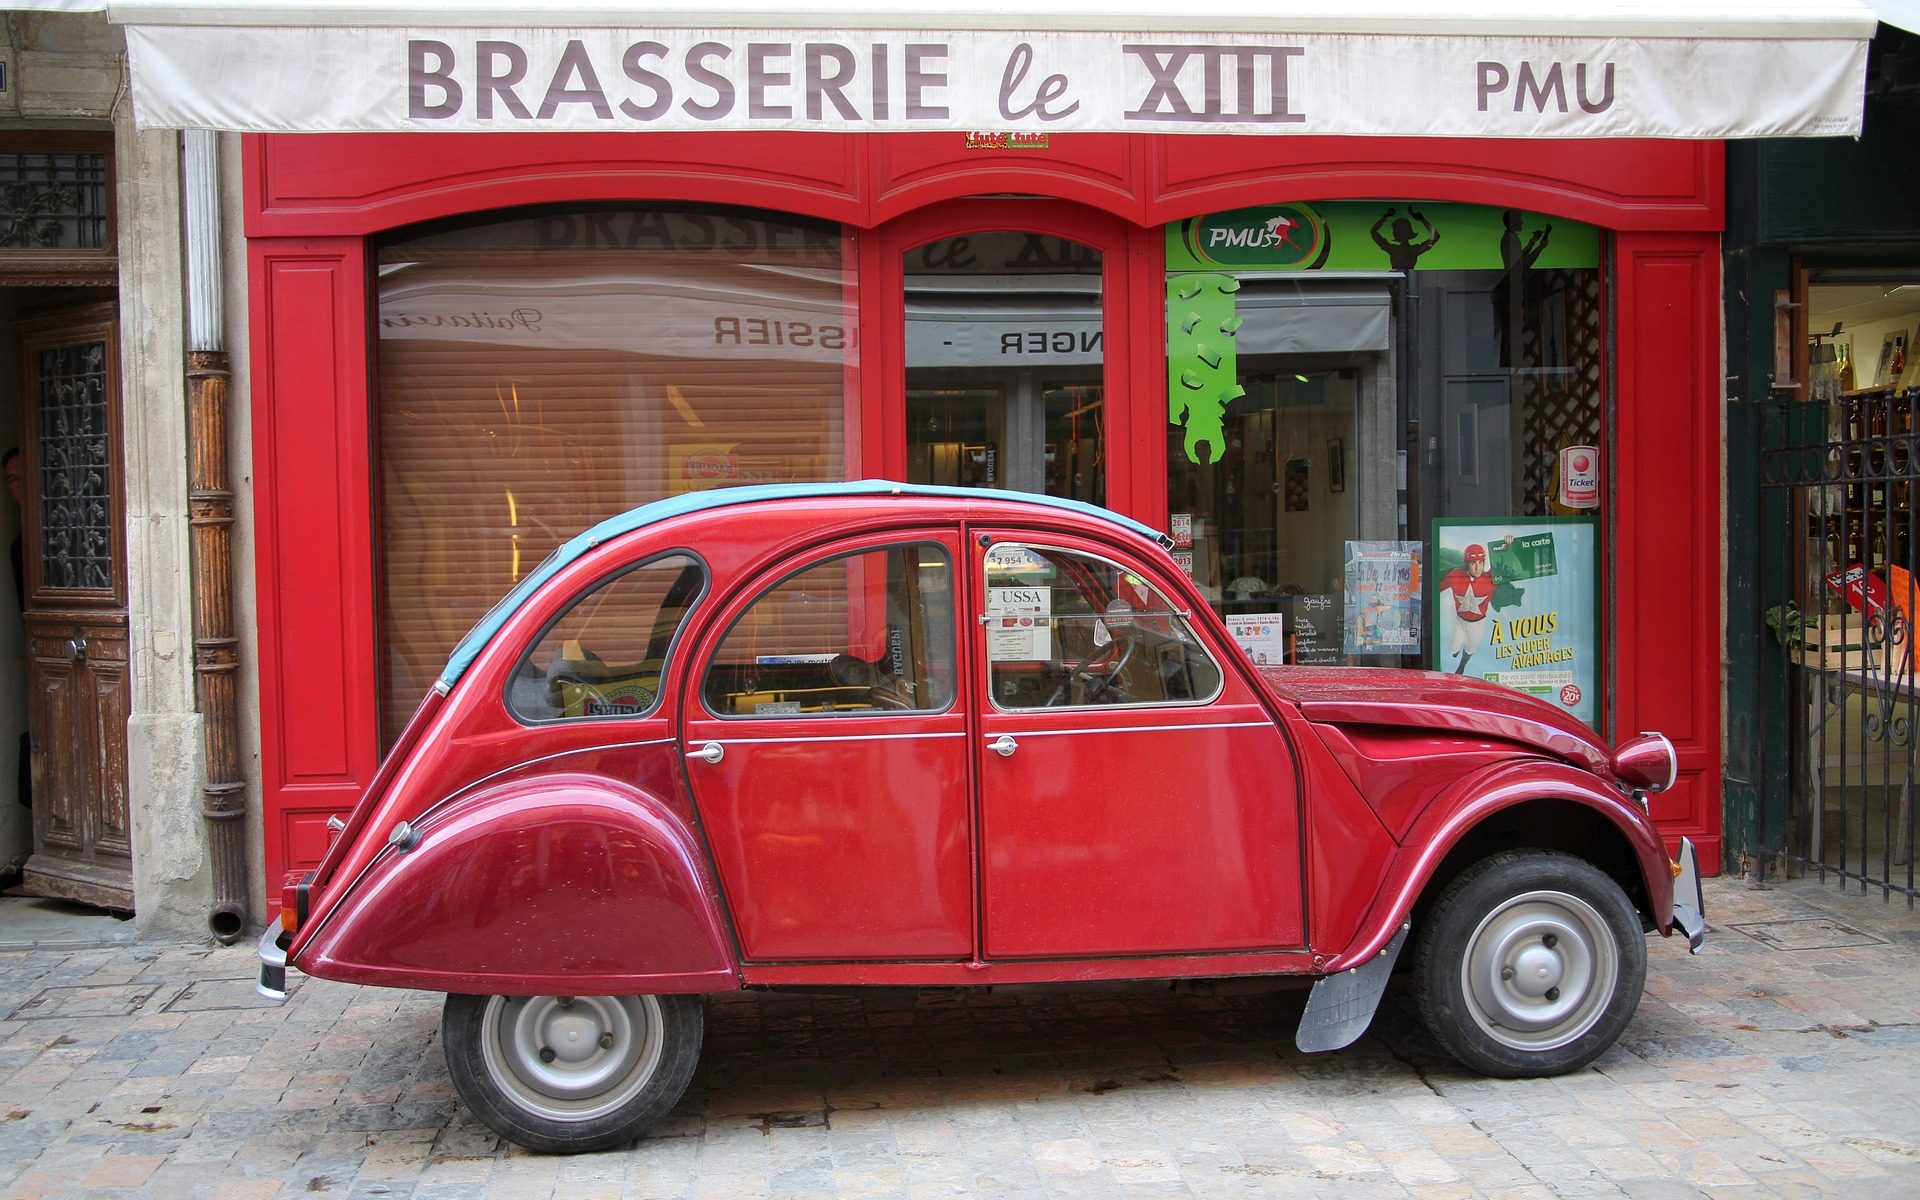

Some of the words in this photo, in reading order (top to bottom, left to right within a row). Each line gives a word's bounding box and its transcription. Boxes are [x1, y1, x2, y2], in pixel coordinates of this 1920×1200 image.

[407, 39, 950, 121] BRASSERIE
[999, 42, 1080, 122] le
[1122, 44, 1306, 123] XIII
[1476, 61, 1616, 114] PMU
[1209, 228, 1265, 248] PMU
[1569, 478, 1595, 487] Ticket
[1172, 519, 1190, 527] 2014
[1532, 537, 1551, 547] carte
[1002, 590, 1041, 603] USSA
[1490, 619, 1504, 645] À
[1509, 611, 1557, 641] VOUS
[1495, 644, 1513, 659] LES
[1516, 637, 1550, 655] SUPER
[1511, 647, 1574, 670] AVANTAGES
